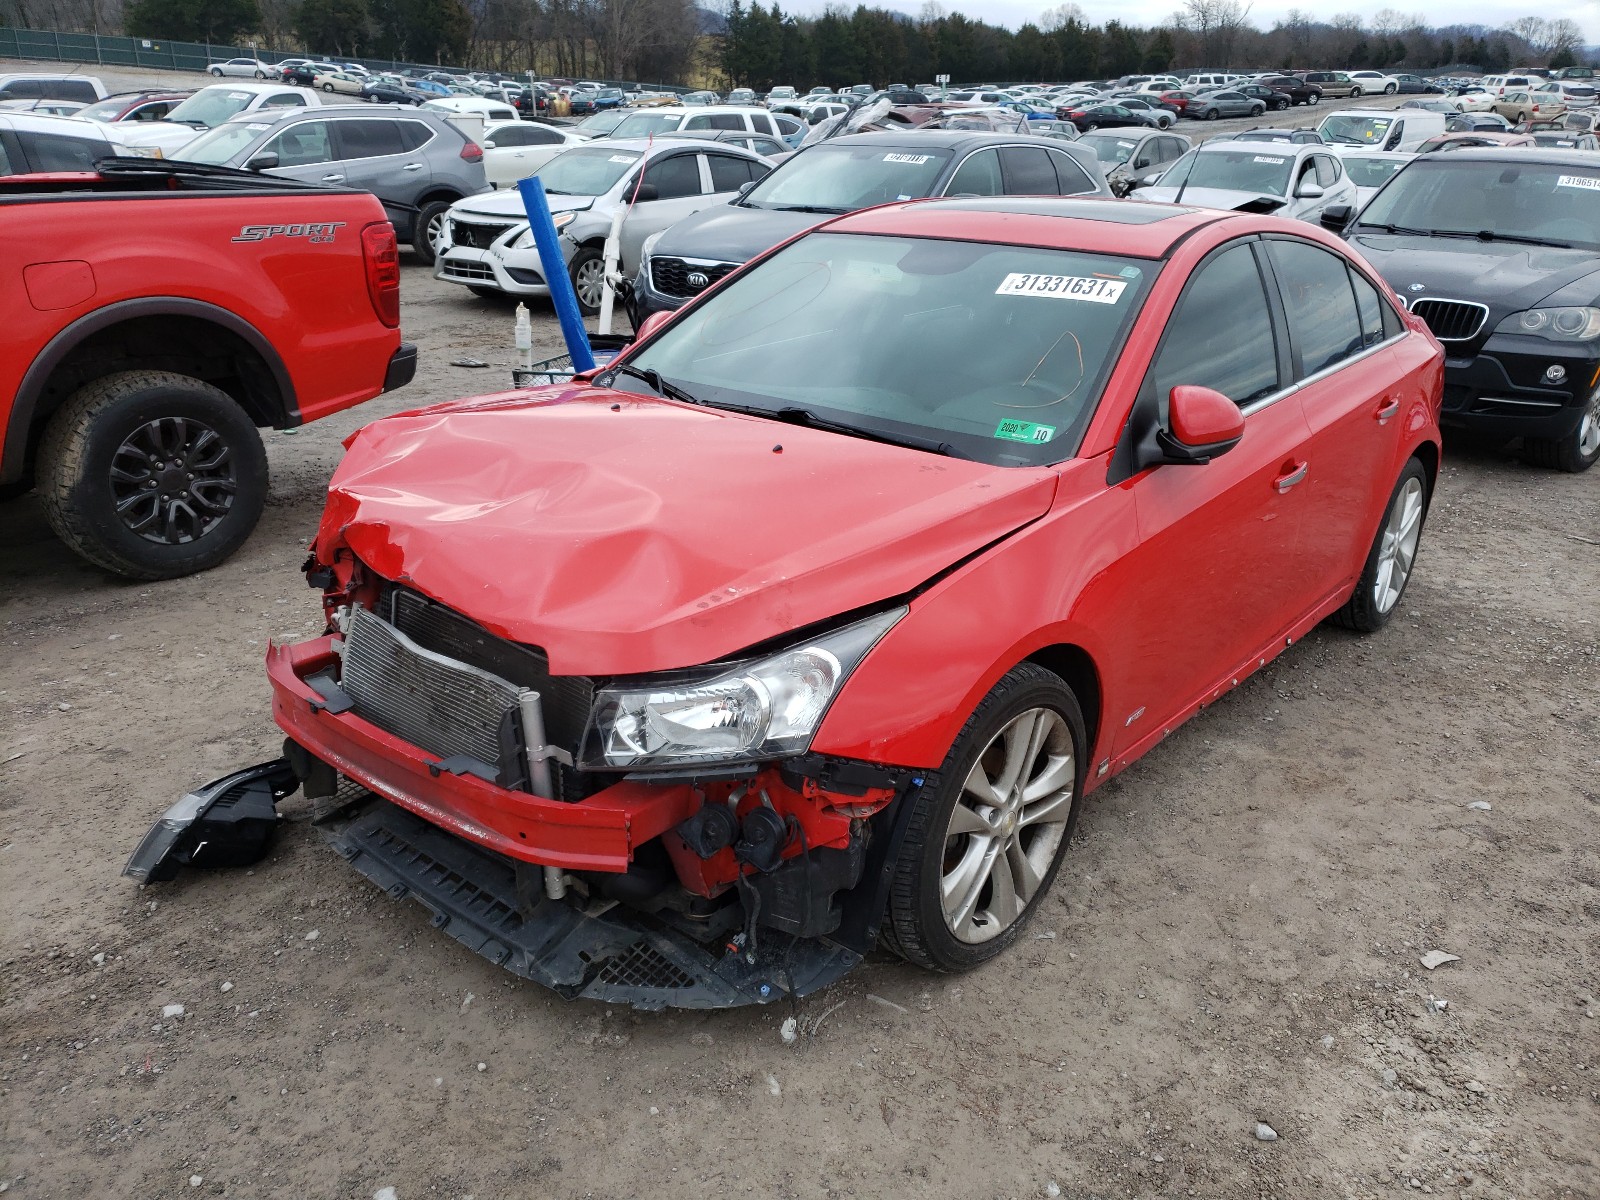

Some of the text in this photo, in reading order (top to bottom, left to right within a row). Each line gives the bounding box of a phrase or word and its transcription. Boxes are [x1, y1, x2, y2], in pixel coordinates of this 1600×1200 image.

[230, 222, 347, 242] SPORT
[689, 275, 705, 286] KIA
[1000, 422, 1048, 441] 2020 10
